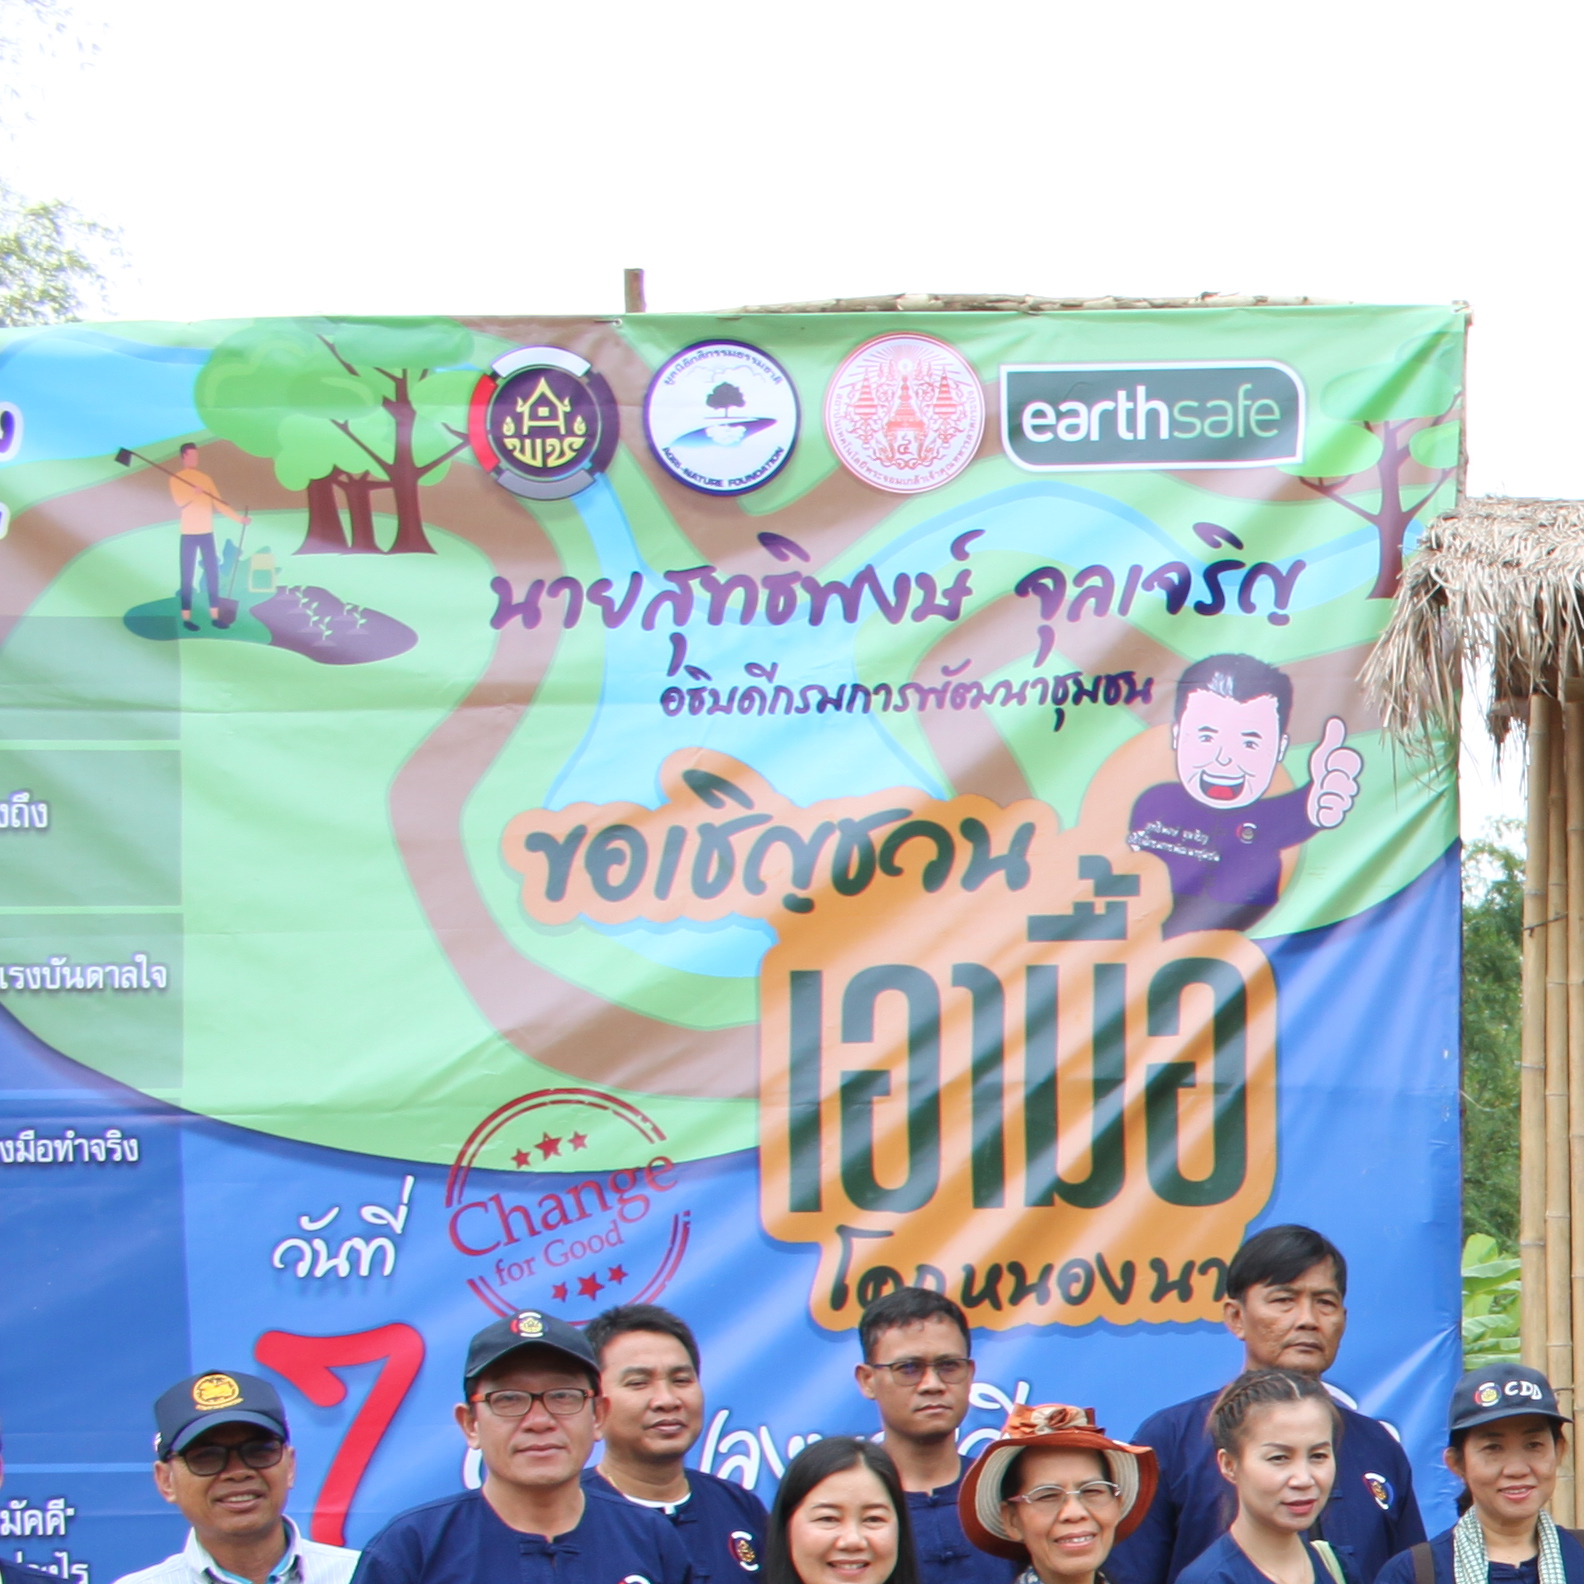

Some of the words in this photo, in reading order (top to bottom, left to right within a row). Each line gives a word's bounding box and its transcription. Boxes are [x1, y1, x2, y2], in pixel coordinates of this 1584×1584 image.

[1020, 384, 1282, 445] earthsafe
[728, 446, 784, 487] FOUNDATION
[489, 528, 987, 678] นายสุทธิพงษ์
[1013, 521, 1307, 670] จุลเจริญ
[660, 658, 1155, 732] อธิบดีกรมการพัฒนาชุมชน
[525, 766, 1035, 913] ขอเชิญชวน
[788, 855, 1248, 1213] เอามื้อ
[272, 1174, 415, 1279] วันที่
[448, 1155, 678, 1257] Change
[495, 1257, 536, 1288] for
[542, 1219, 625, 1267] Good
[254, 1322, 426, 1548] 7
[1504, 1381, 1543, 1400] CDD
